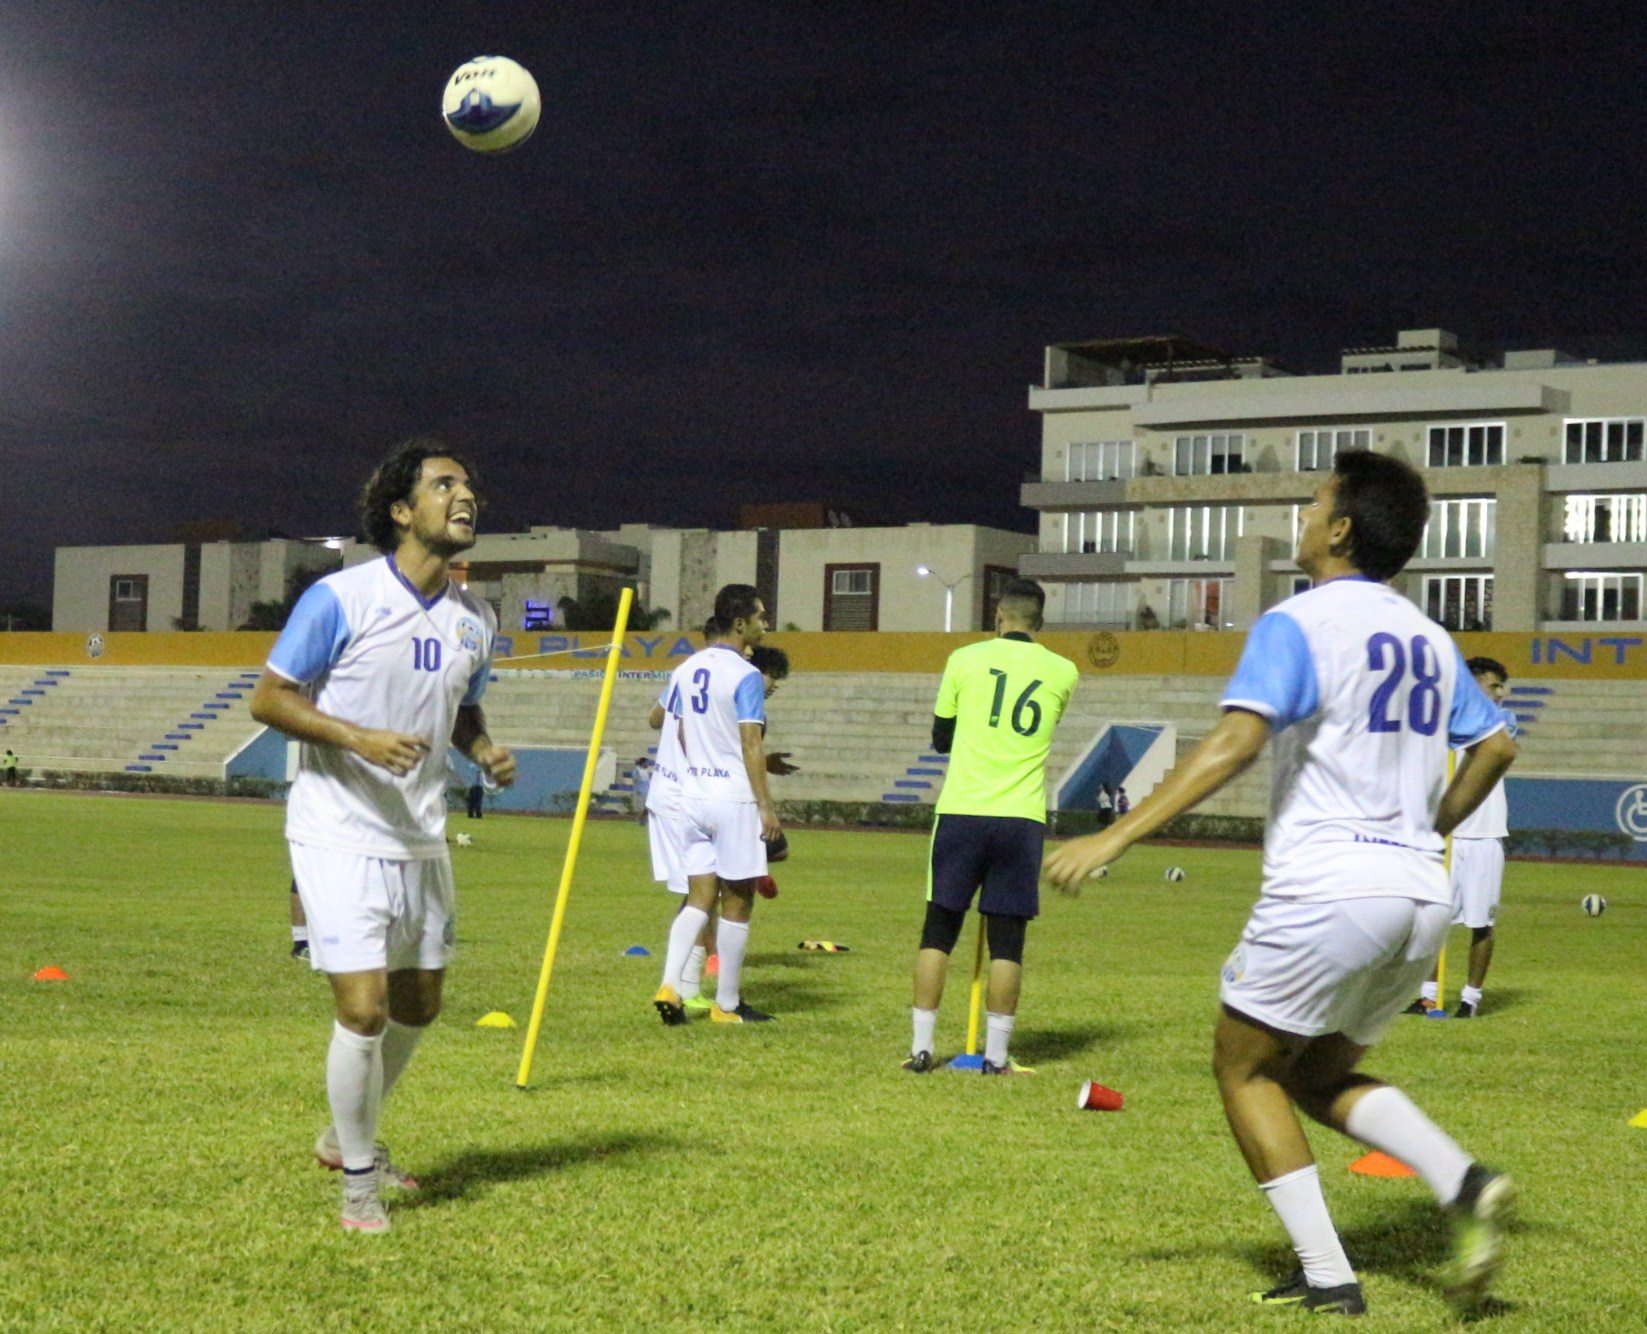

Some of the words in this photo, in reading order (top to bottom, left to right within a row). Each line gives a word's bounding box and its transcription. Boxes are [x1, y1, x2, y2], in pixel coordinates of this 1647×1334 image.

[412, 636, 441, 672] 10
[691, 668, 711, 714] 3
[988, 668, 1044, 737] 16
[1367, 632, 1441, 737] 28
